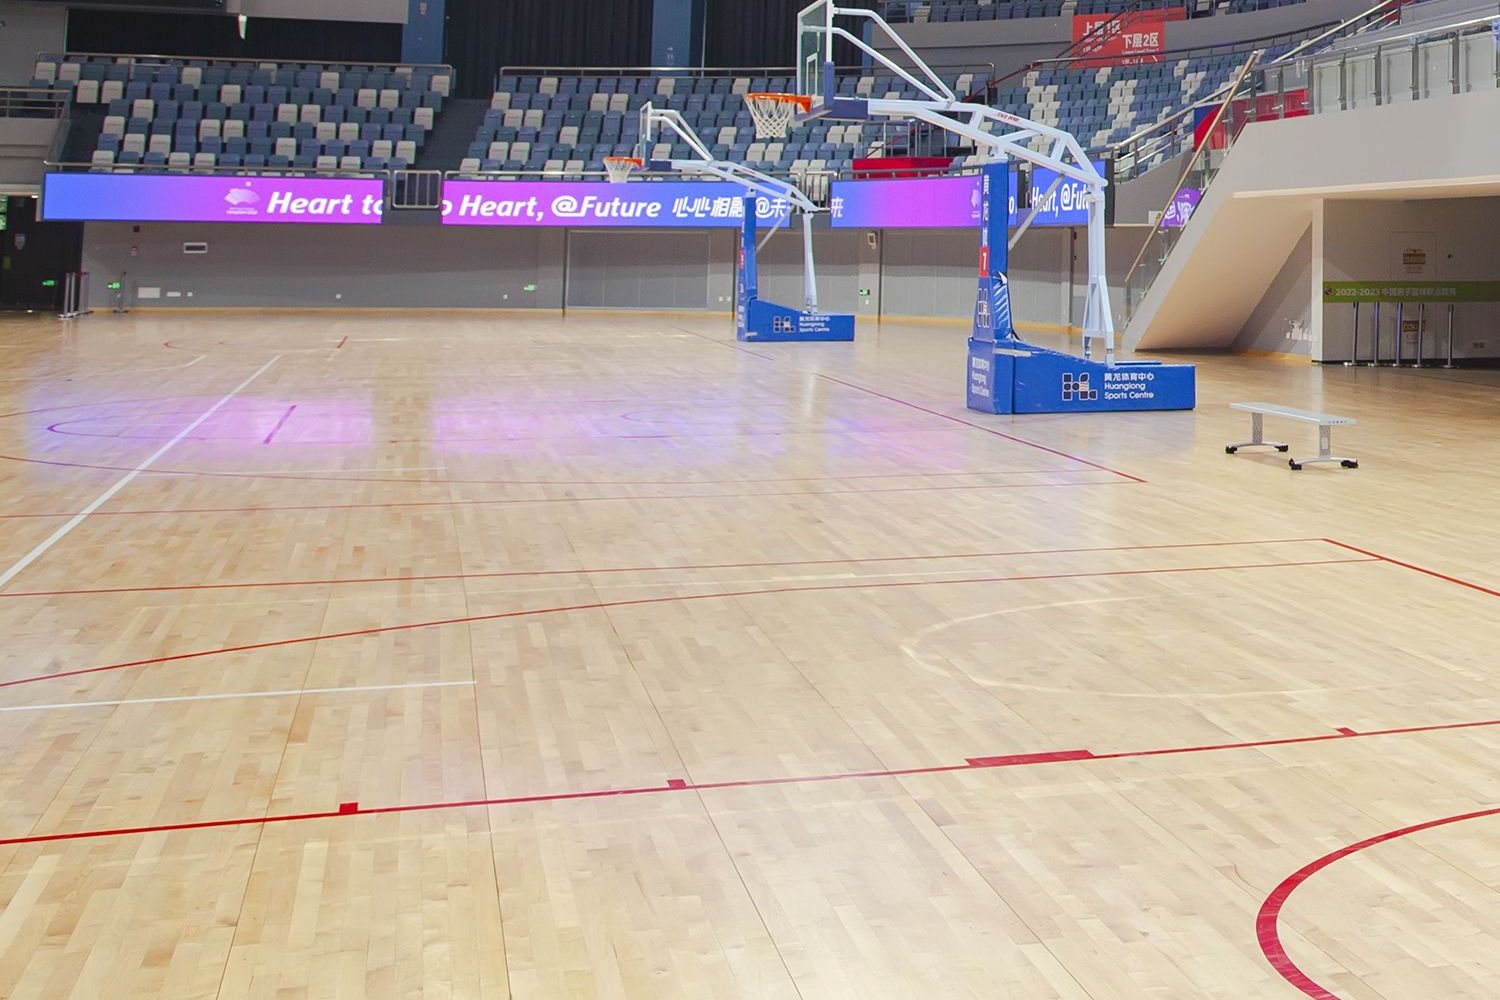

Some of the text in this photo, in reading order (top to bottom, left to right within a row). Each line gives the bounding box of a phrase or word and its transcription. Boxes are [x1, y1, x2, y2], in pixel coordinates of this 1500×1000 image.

[1122, 32, 1159, 49] 下层2区
[267, 191, 353, 215] Heart
[458, 194, 544, 221] Heart,
[551, 195, 661, 218] @Future
[1104, 382, 1146, 391] Huanglong
[1104, 391, 1154, 400] Sports Centre
